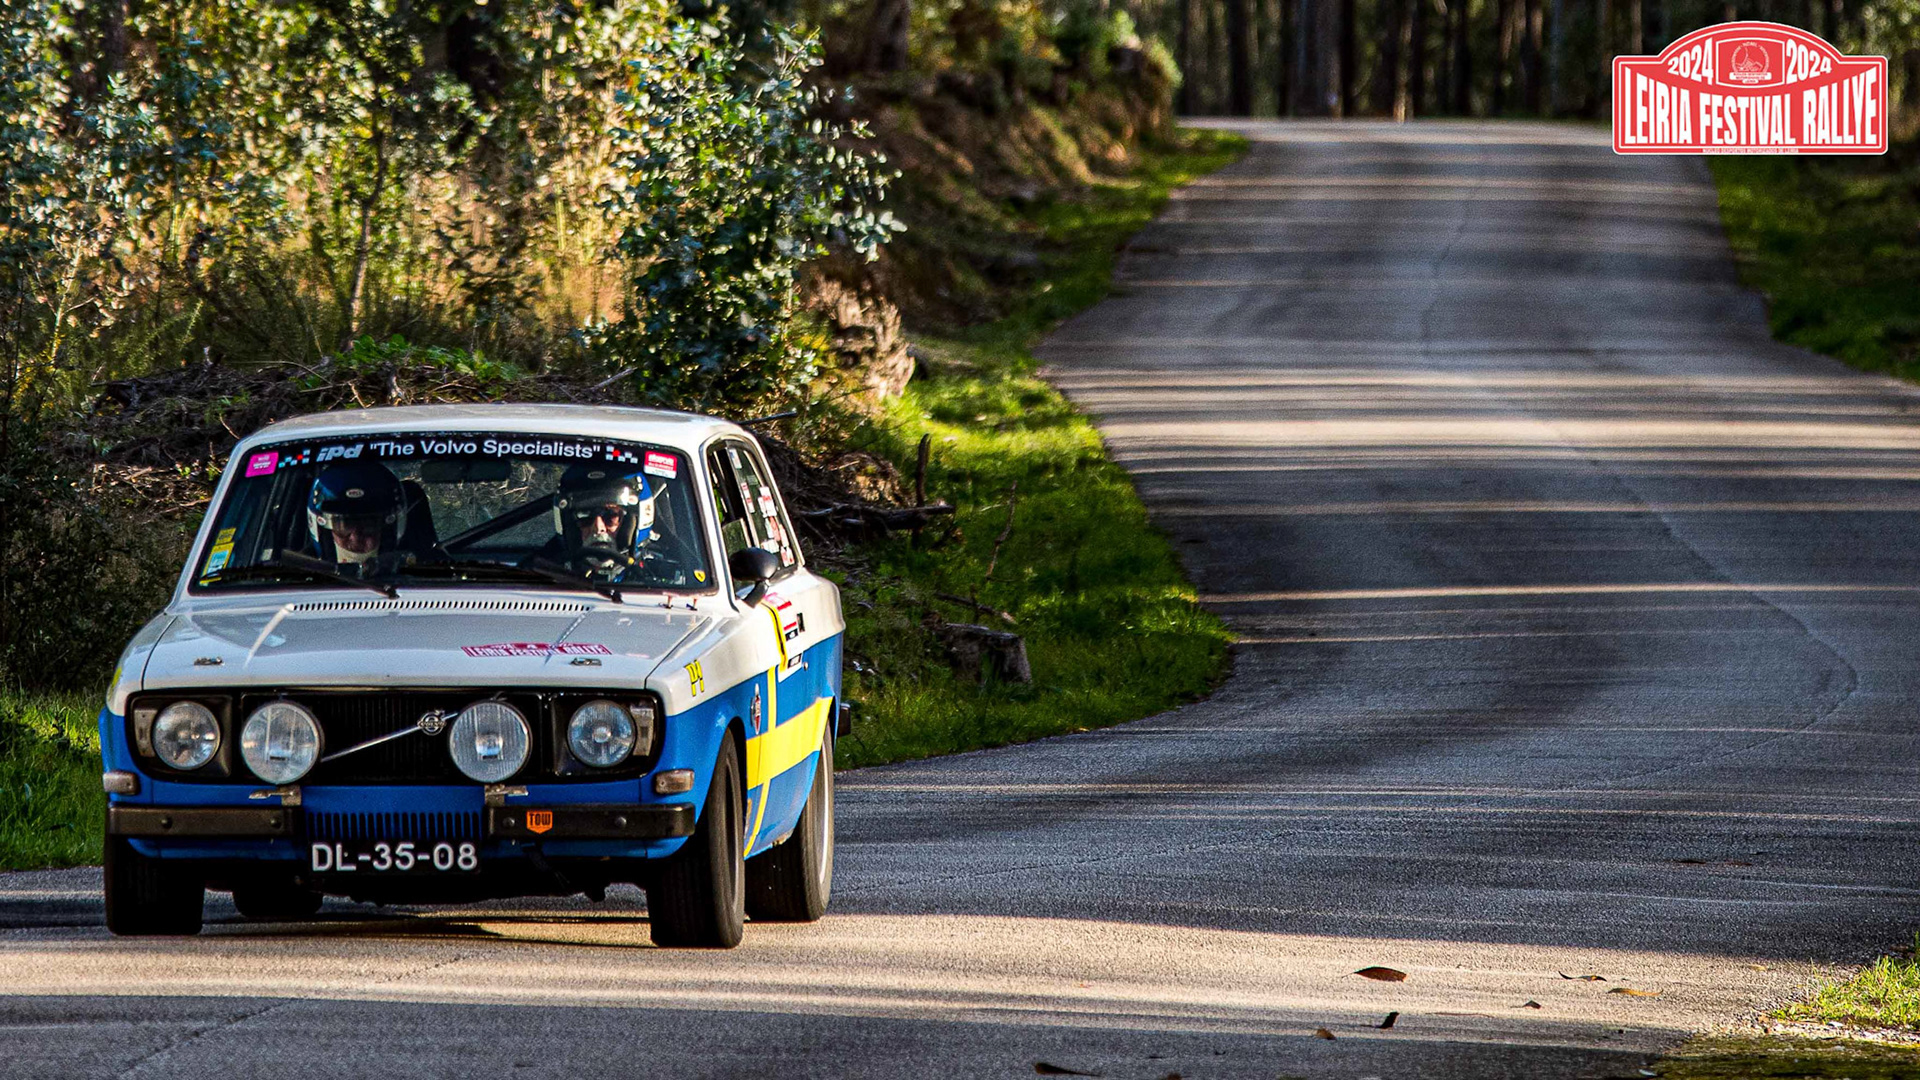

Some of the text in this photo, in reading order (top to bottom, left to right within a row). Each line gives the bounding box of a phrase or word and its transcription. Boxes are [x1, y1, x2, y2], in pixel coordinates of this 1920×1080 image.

[370, 440, 600, 459] "The Volvo Specialists"
[529, 813, 551, 827] TOW
[312, 842, 478, 871] DL-35-08
